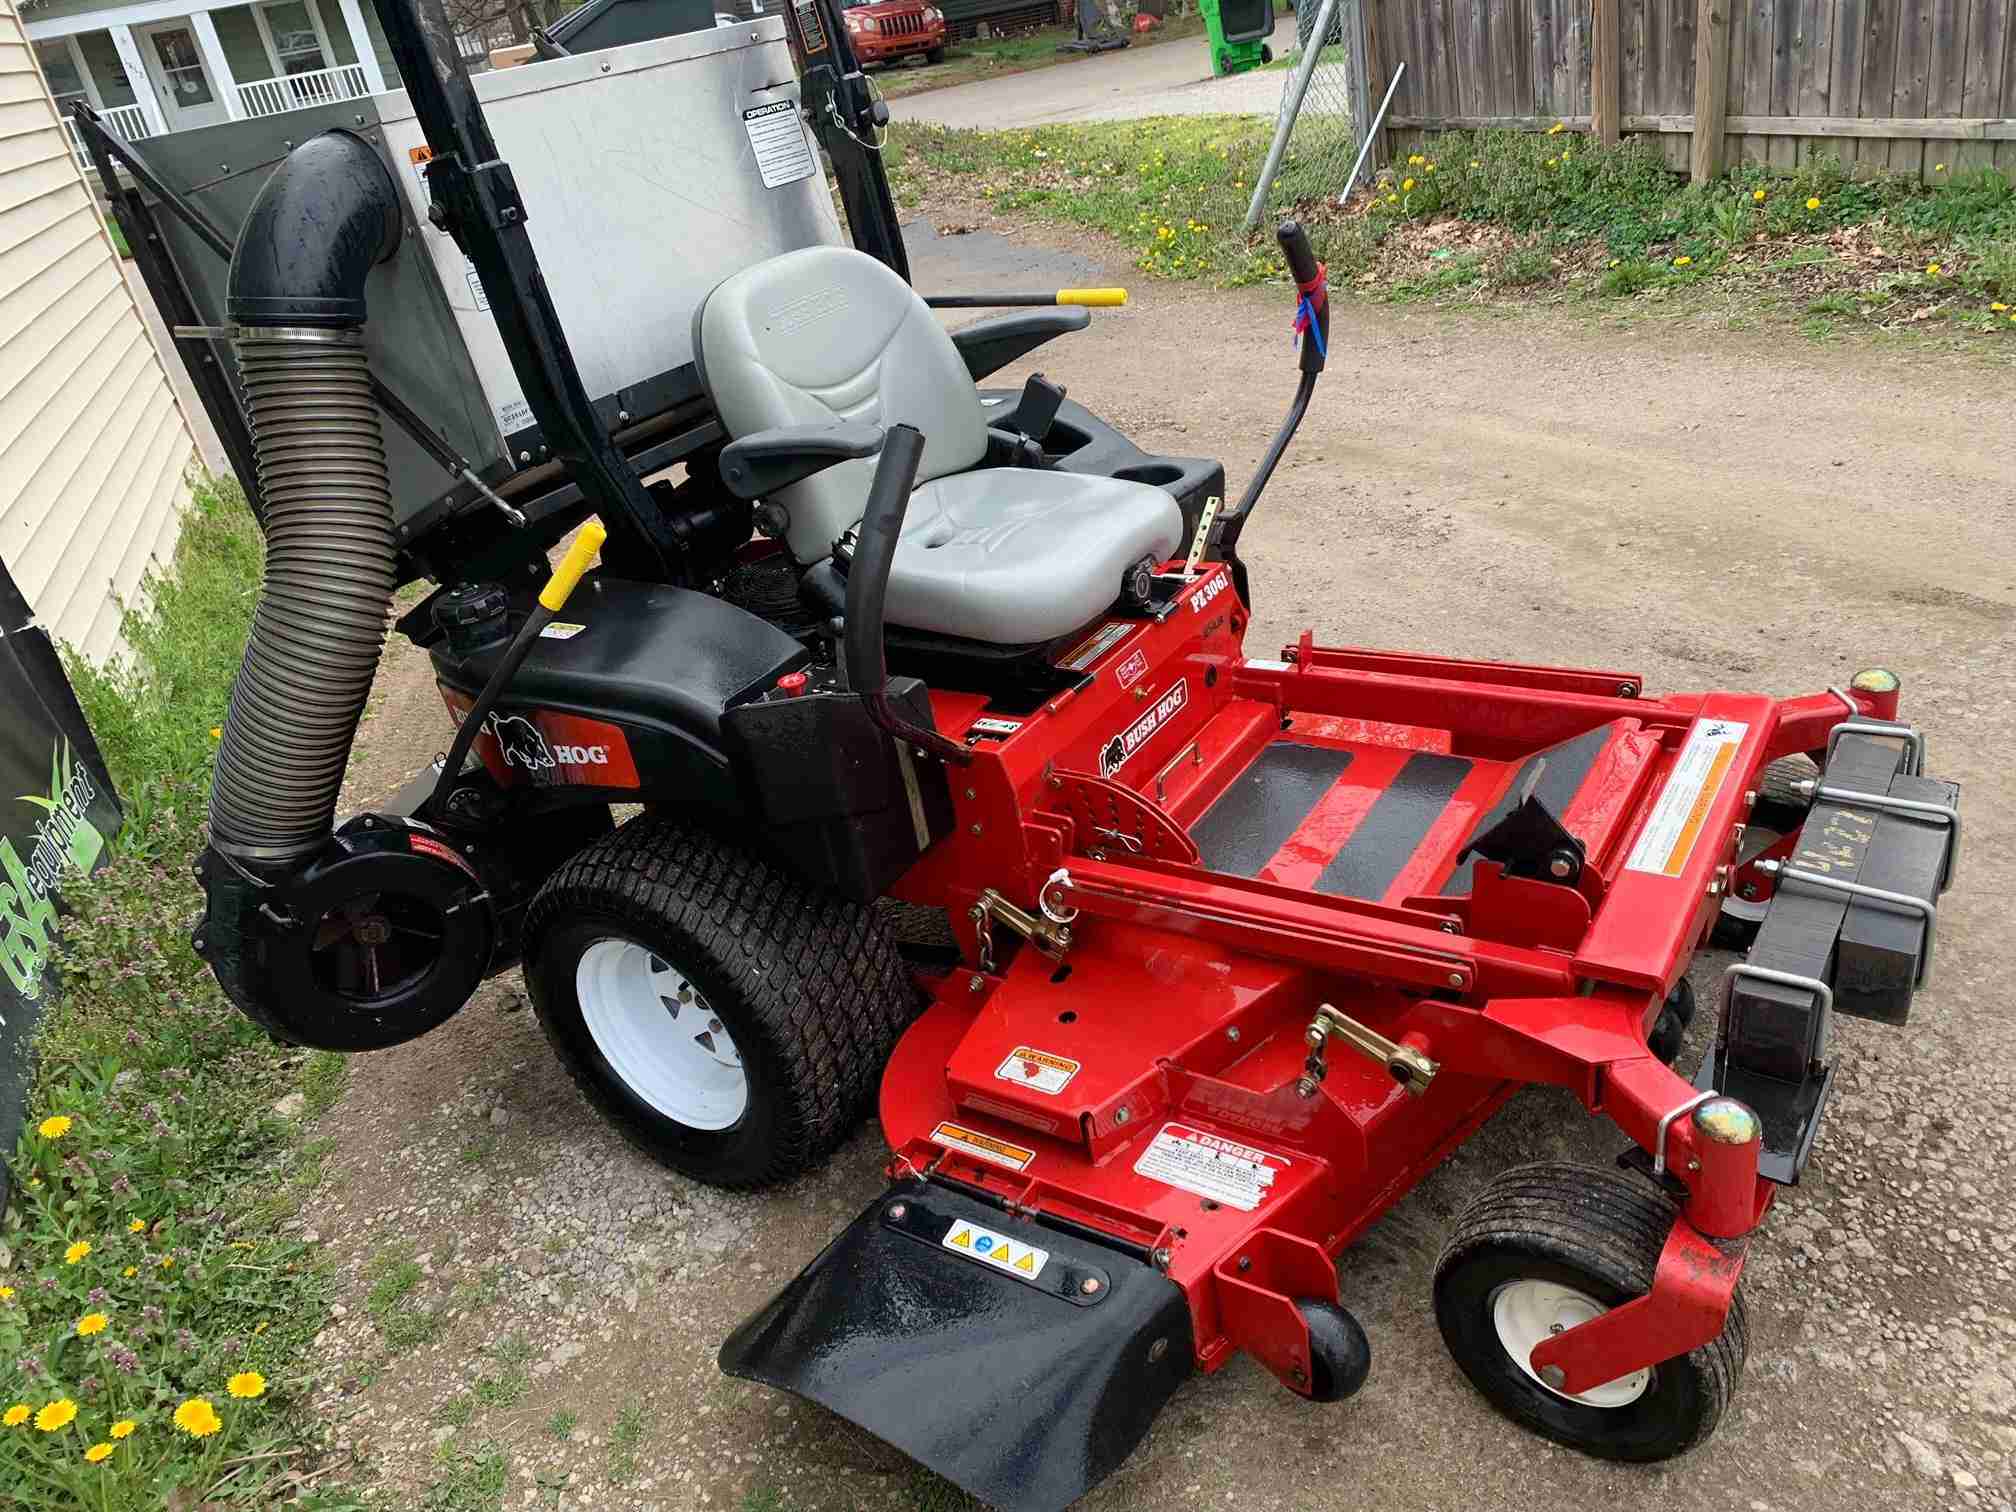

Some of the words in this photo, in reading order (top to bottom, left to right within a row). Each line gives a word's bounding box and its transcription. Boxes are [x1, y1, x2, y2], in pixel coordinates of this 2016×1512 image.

[746, 102, 790, 119] OPERATION
[1190, 589, 1207, 614] PZ
[1203, 571, 1228, 601] 3061
[1125, 709, 1157, 752] BUSH
[1157, 685, 1183, 722] HOG
[553, 745, 609, 764] HOG
[24, 760, 96, 900] equipment
[1200, 1134, 1266, 1164] DANGER
